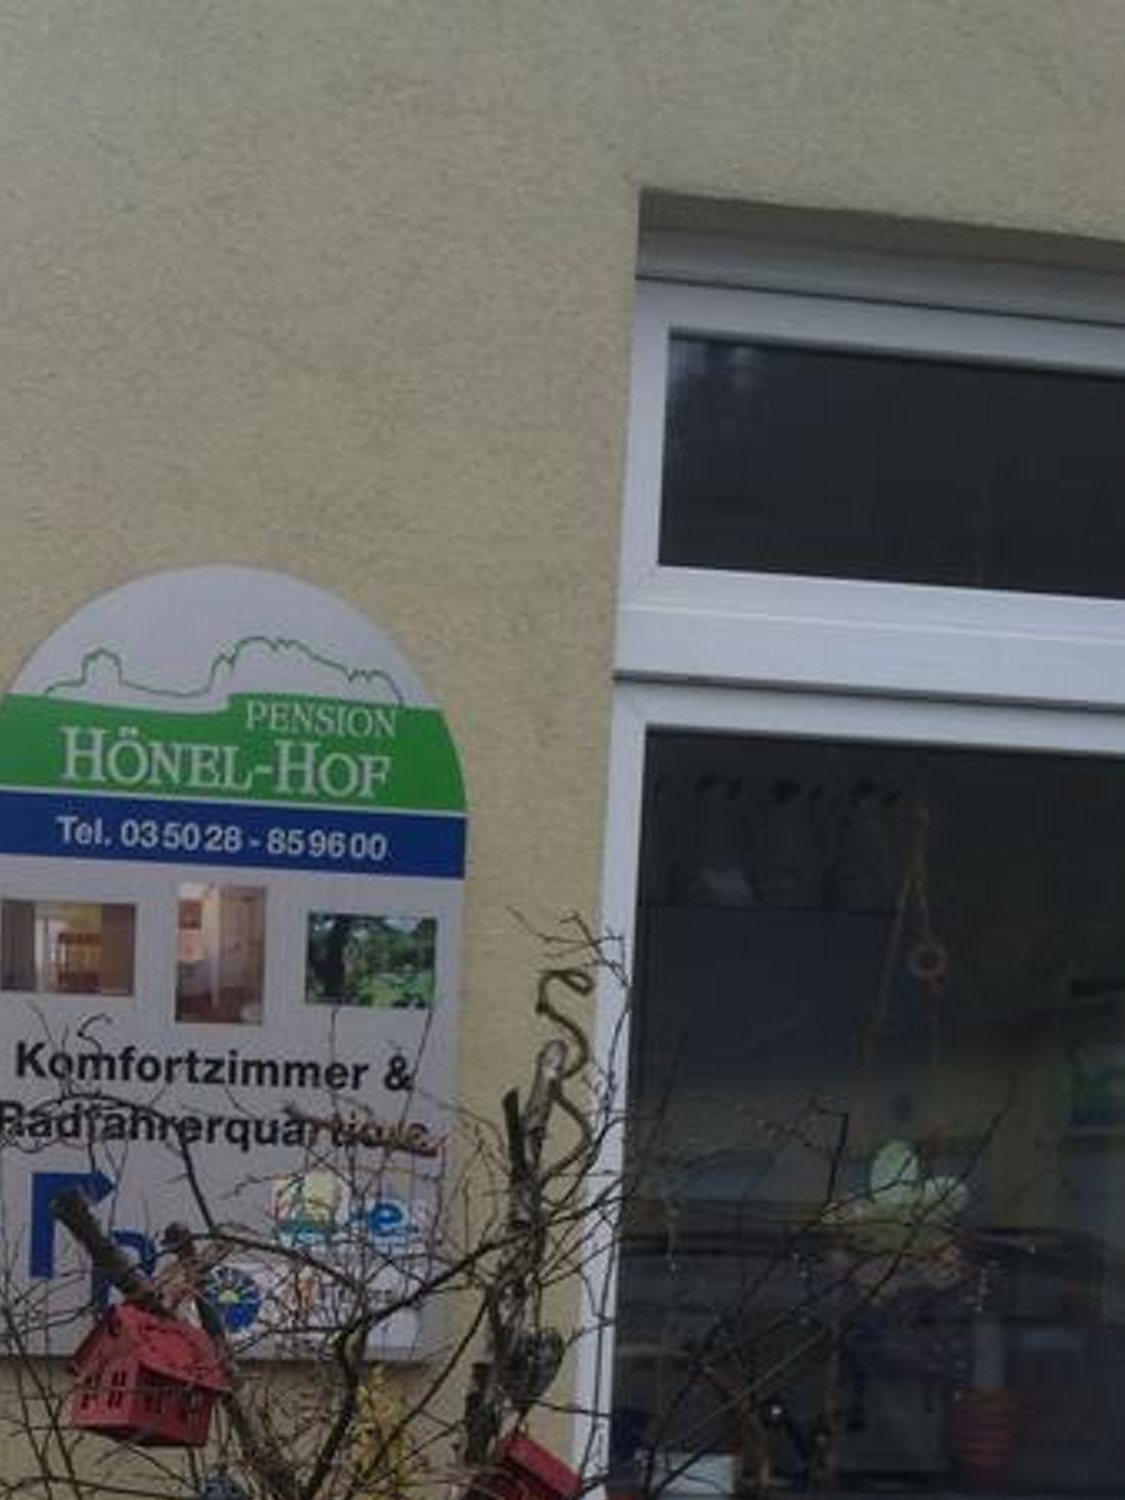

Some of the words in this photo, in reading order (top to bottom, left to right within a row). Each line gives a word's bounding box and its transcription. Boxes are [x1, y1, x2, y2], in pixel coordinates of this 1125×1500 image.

[246, 701, 397, 738] PENSION
[62, 725, 392, 799] HÖNEL-HOF
[57, 815, 112, 847] Tel.
[15, 1040, 370, 1092] Komfortzimmer
[383, 1055, 413, 1092] &
